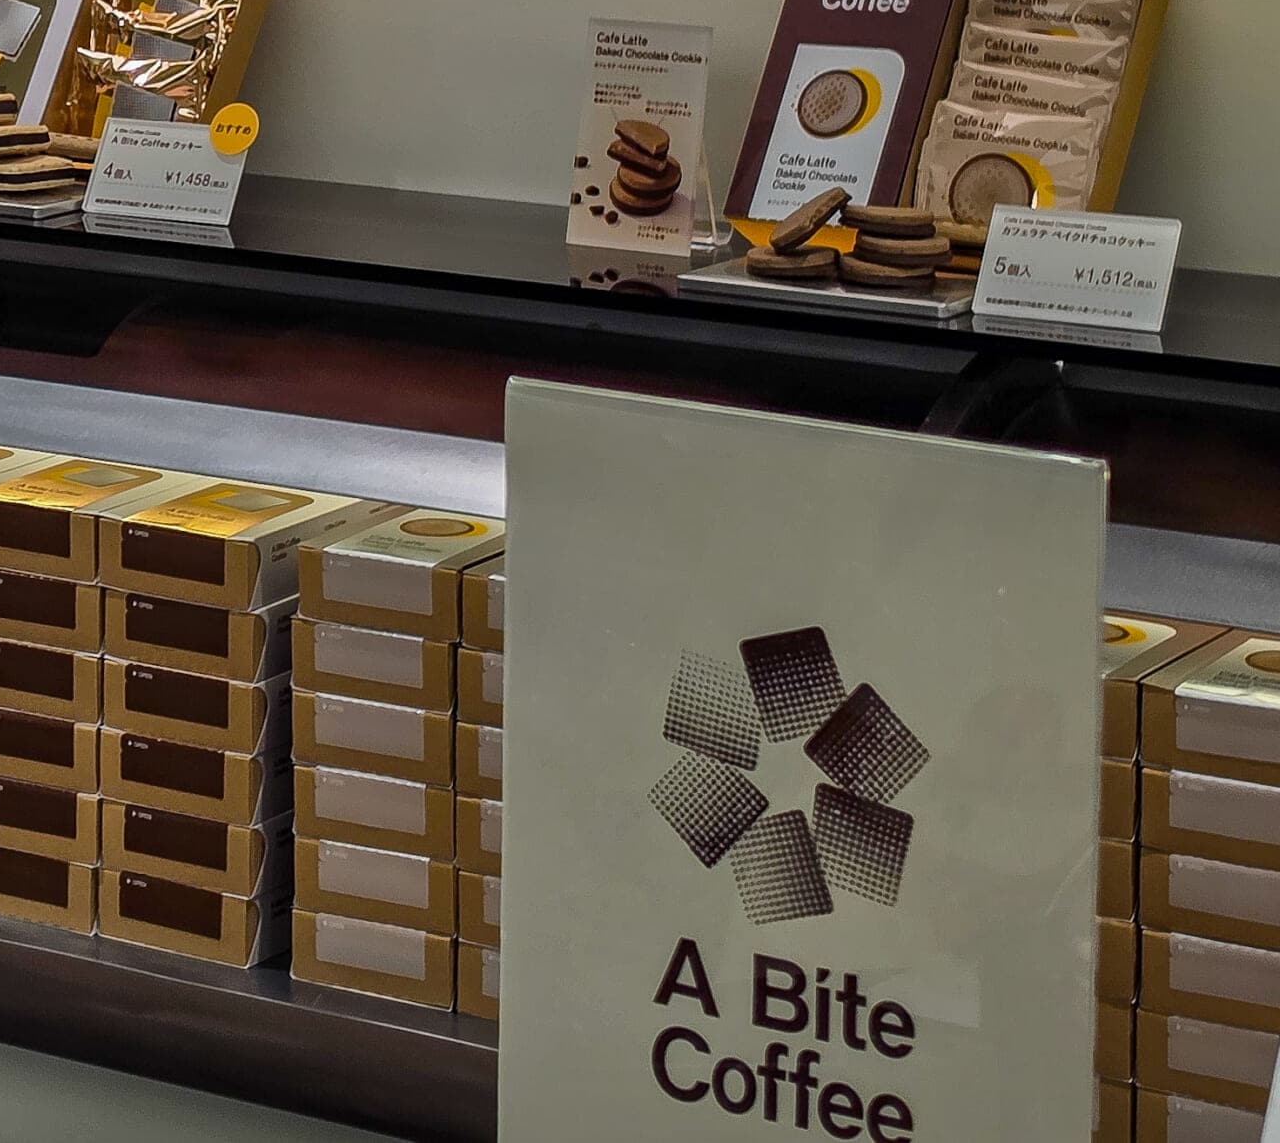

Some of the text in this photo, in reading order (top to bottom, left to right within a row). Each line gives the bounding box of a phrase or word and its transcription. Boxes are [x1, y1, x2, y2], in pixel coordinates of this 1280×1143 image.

[597, 32, 648, 46] Cafe Latte
[985, 38, 1039, 54] Cafe Latte
[595, 47, 702, 64] Baked Chocolate Cookie
[974, 75, 999, 88] Cafe
[954, 114, 978, 128] Cafe
[215, 123, 252, 136] おすすめ
[111, 136, 203, 150] A Bite Coffee クッキー
[779, 153, 837, 169] Cafe Latte
[103, 161, 133, 181] 4個入
[776, 168, 858, 185] Baked Chocolate
[772, 181, 806, 193] Cookie
[993, 256, 1032, 278] 5個入
[652, 937, 915, 1059] A Bite
[651, 1026, 915, 1143] Coffee
